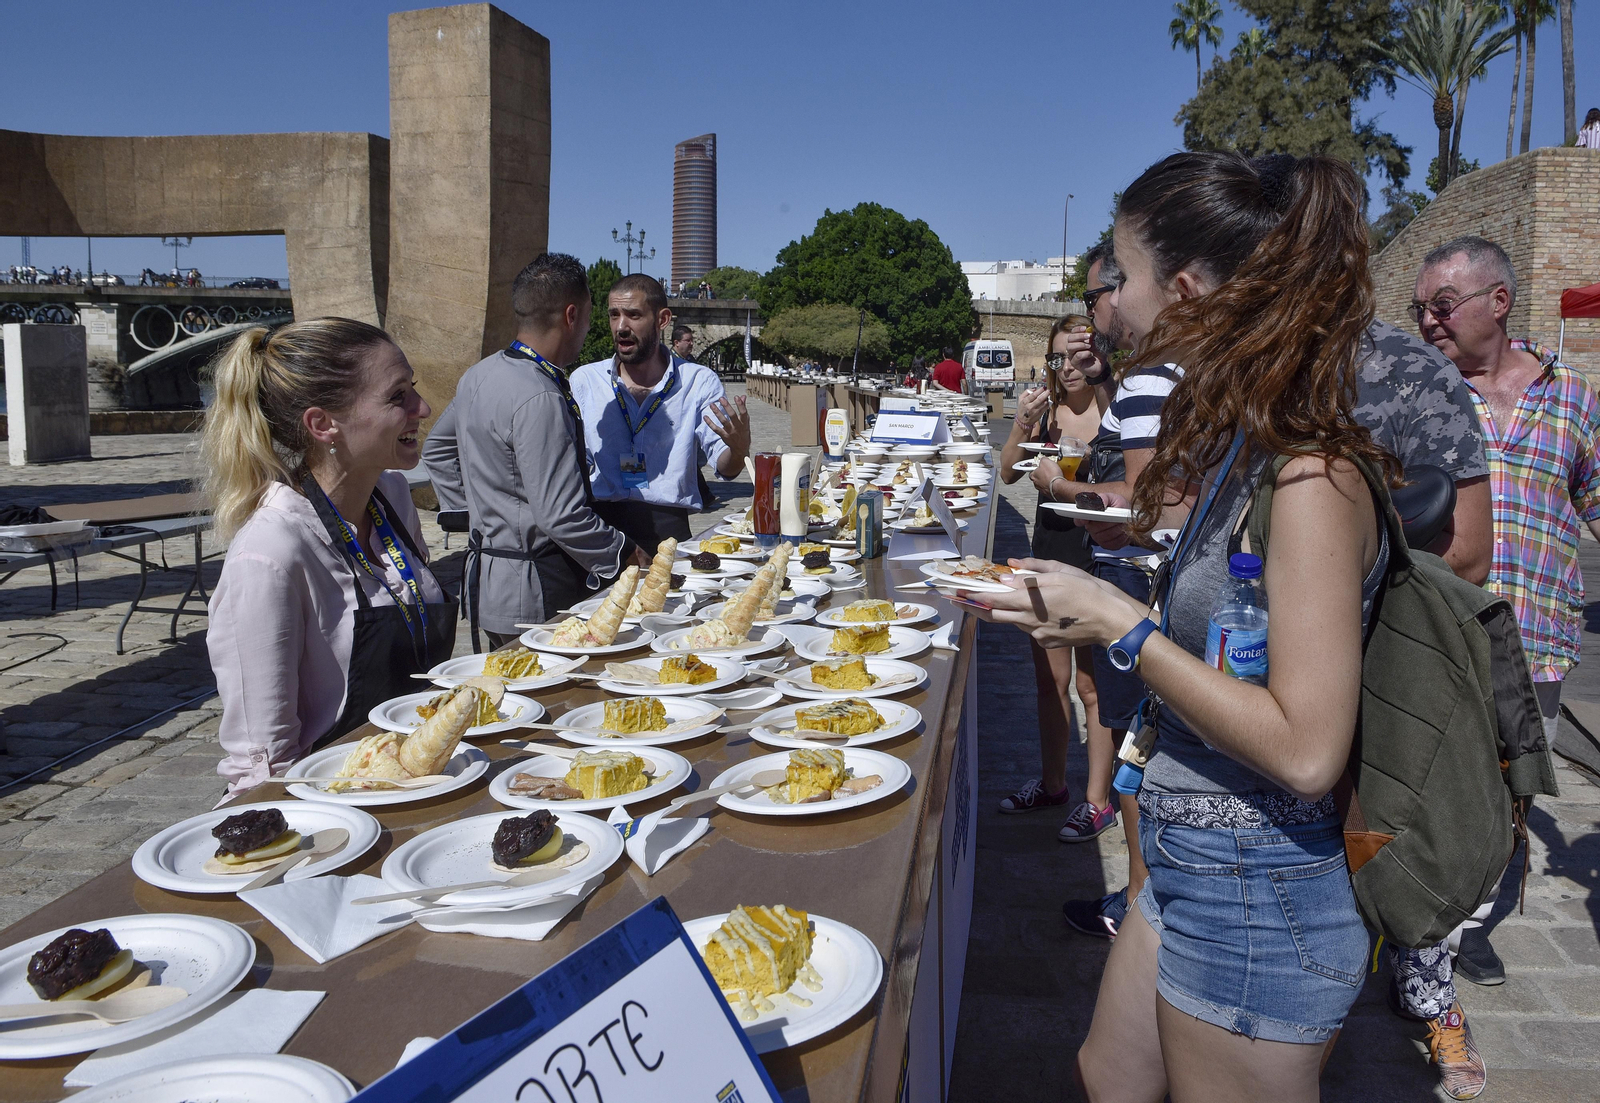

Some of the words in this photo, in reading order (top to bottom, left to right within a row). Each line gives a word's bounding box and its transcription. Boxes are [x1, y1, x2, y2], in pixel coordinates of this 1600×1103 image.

[368, 502, 383, 527] akro
[382, 536, 406, 570] makro
[407, 579, 425, 614] makro
